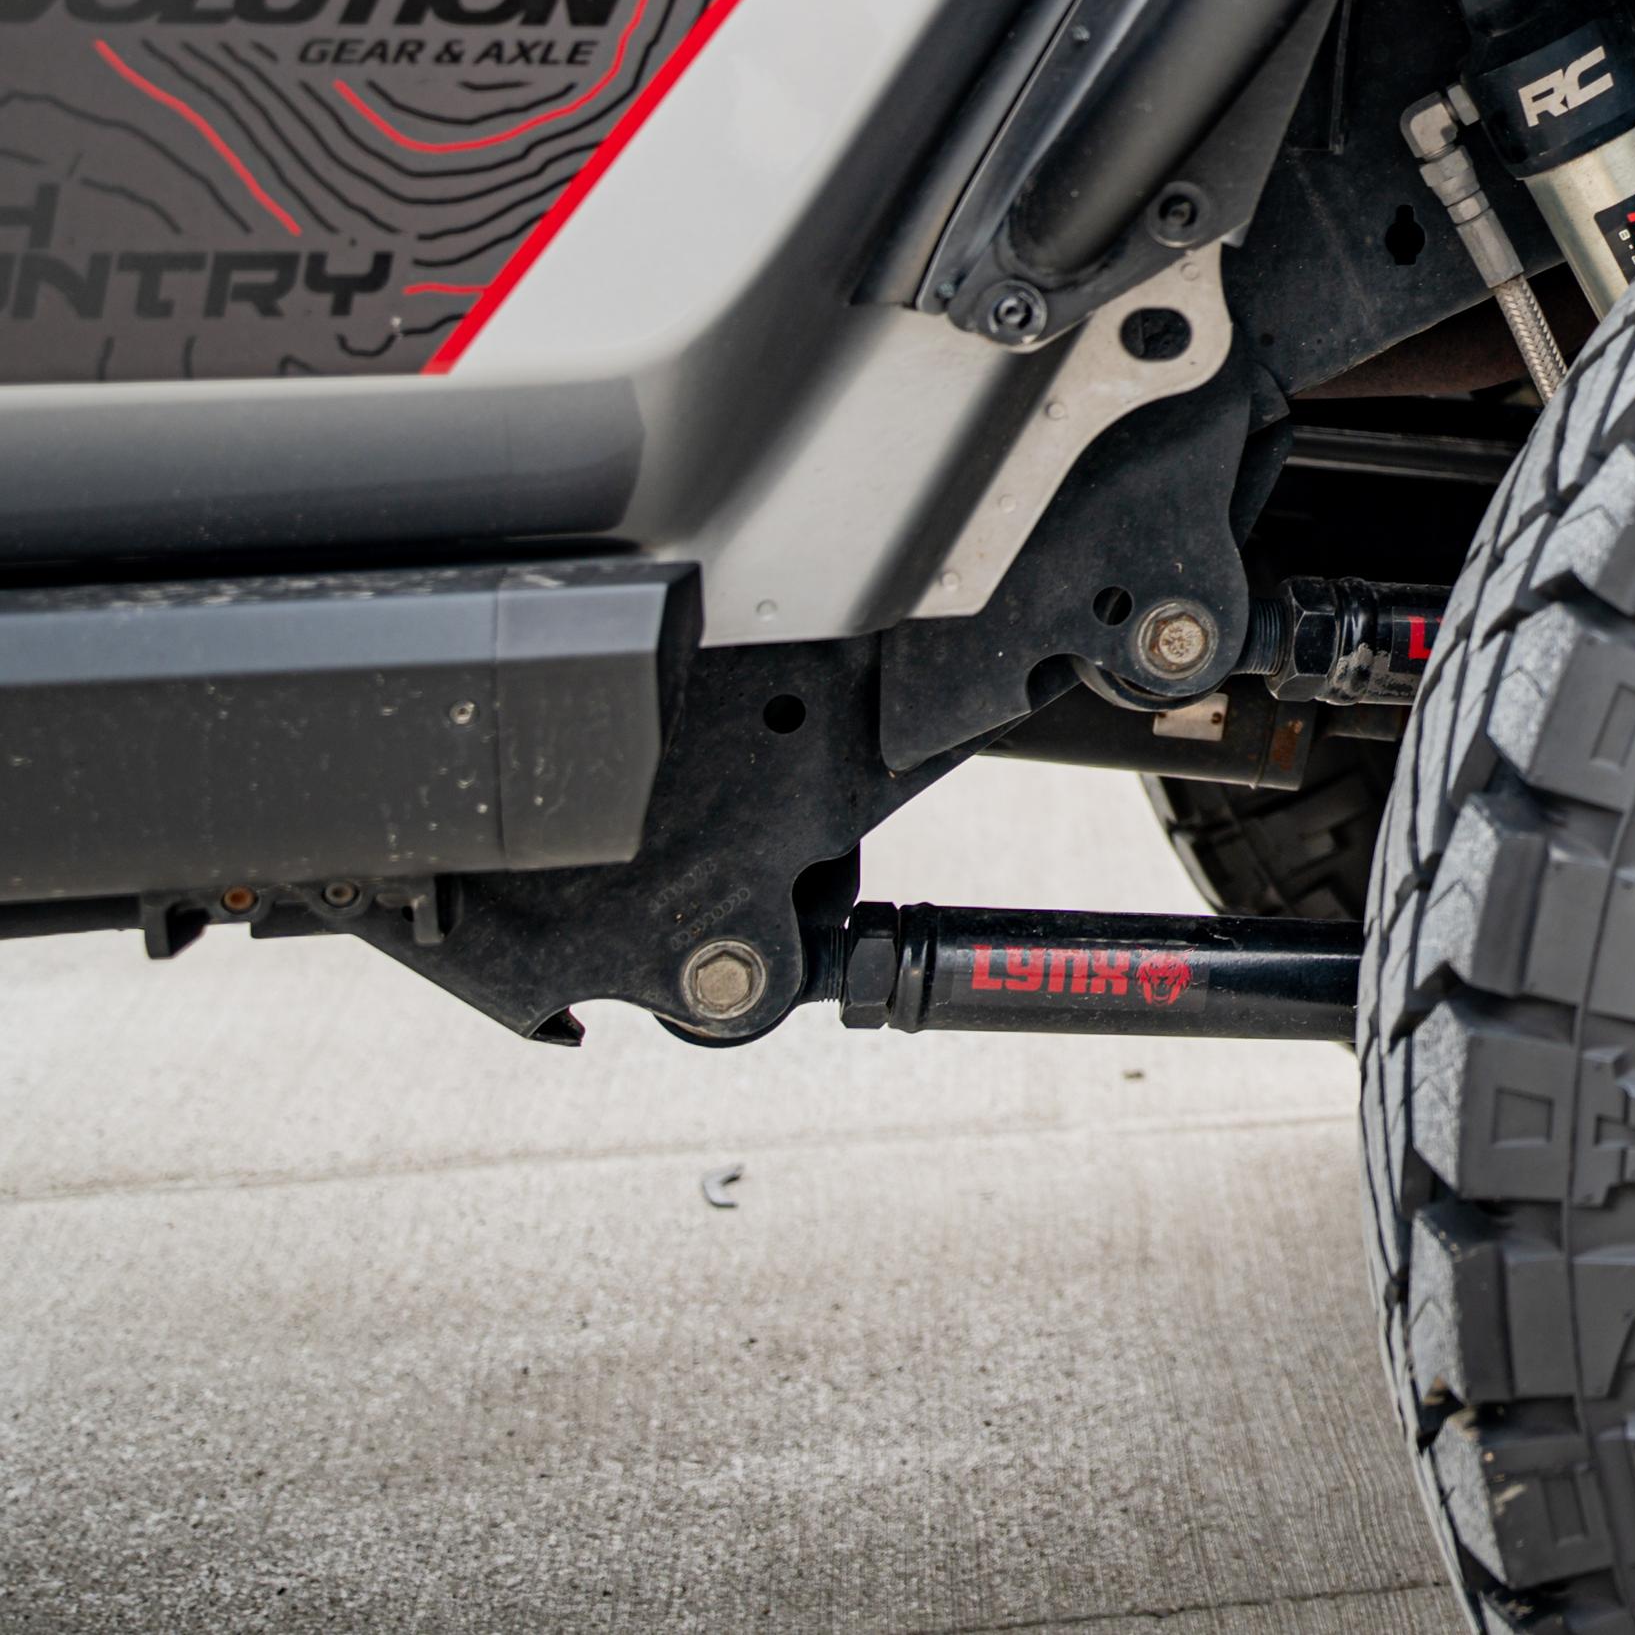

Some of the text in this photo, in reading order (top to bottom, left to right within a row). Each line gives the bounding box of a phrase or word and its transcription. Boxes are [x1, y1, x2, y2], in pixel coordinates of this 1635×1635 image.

[298, 39, 599, 66] GEAR & AXLE
[1518, 45, 1614, 128] RC
[0, 250, 394, 319] NTRY
